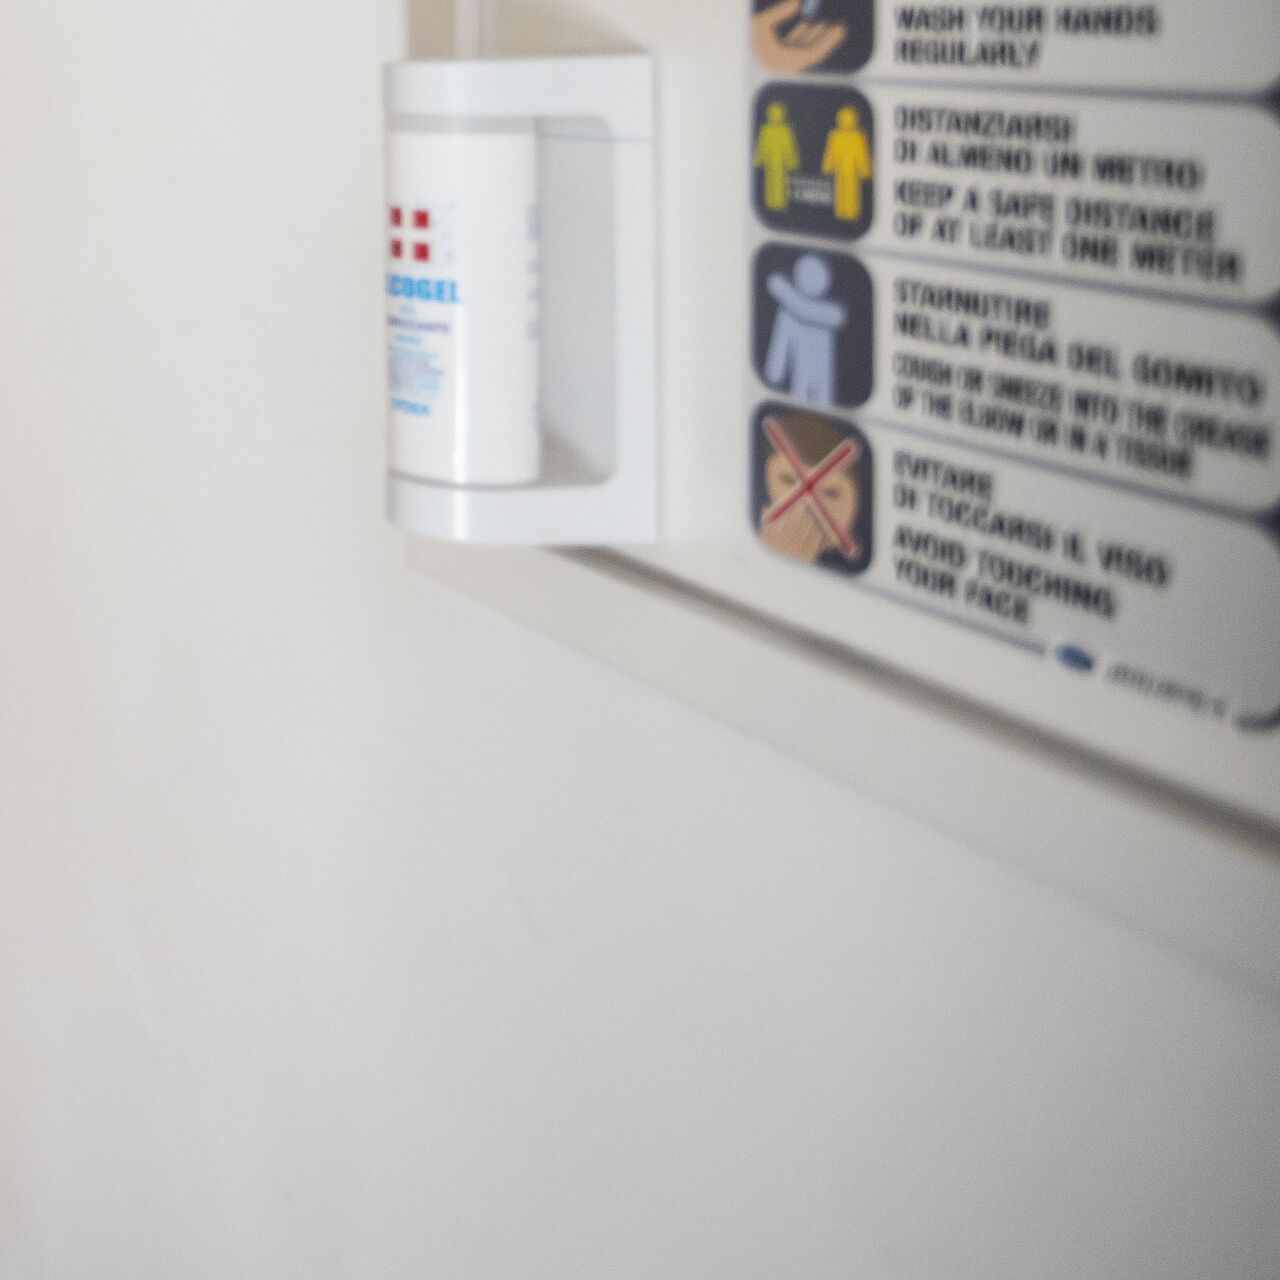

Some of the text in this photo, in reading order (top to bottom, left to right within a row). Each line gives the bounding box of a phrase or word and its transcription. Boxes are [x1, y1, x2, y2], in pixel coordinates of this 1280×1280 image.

[895, 7, 1159, 38] WASH YOUR HANDS
[895, 39, 1040, 69] REGULARLY
[896, 106, 1075, 143] DISTANZIARSI
[894, 139, 1202, 191] DI ALMENO UN METRO
[896, 180, 956, 212] KEEP
[989, 190, 1055, 224] SAFE
[1066, 196, 1216, 242] DISTANCE
[895, 213, 1241, 283] OF AT LEAST ONE METER
[386, 274, 459, 304] COGEL
[895, 278, 1052, 328] STARNUTIRE
[895, 313, 1265, 406] NELLA PIEGA DEL GOMITO
[893, 388, 915, 410] OF
[895, 451, 993, 498] EVITARE
[894, 483, 1169, 588] DI TOCCARSI IL VISO
[895, 524, 1117, 621] AVOID TOUCHING
[895, 556, 1030, 622] YOUR FACE
